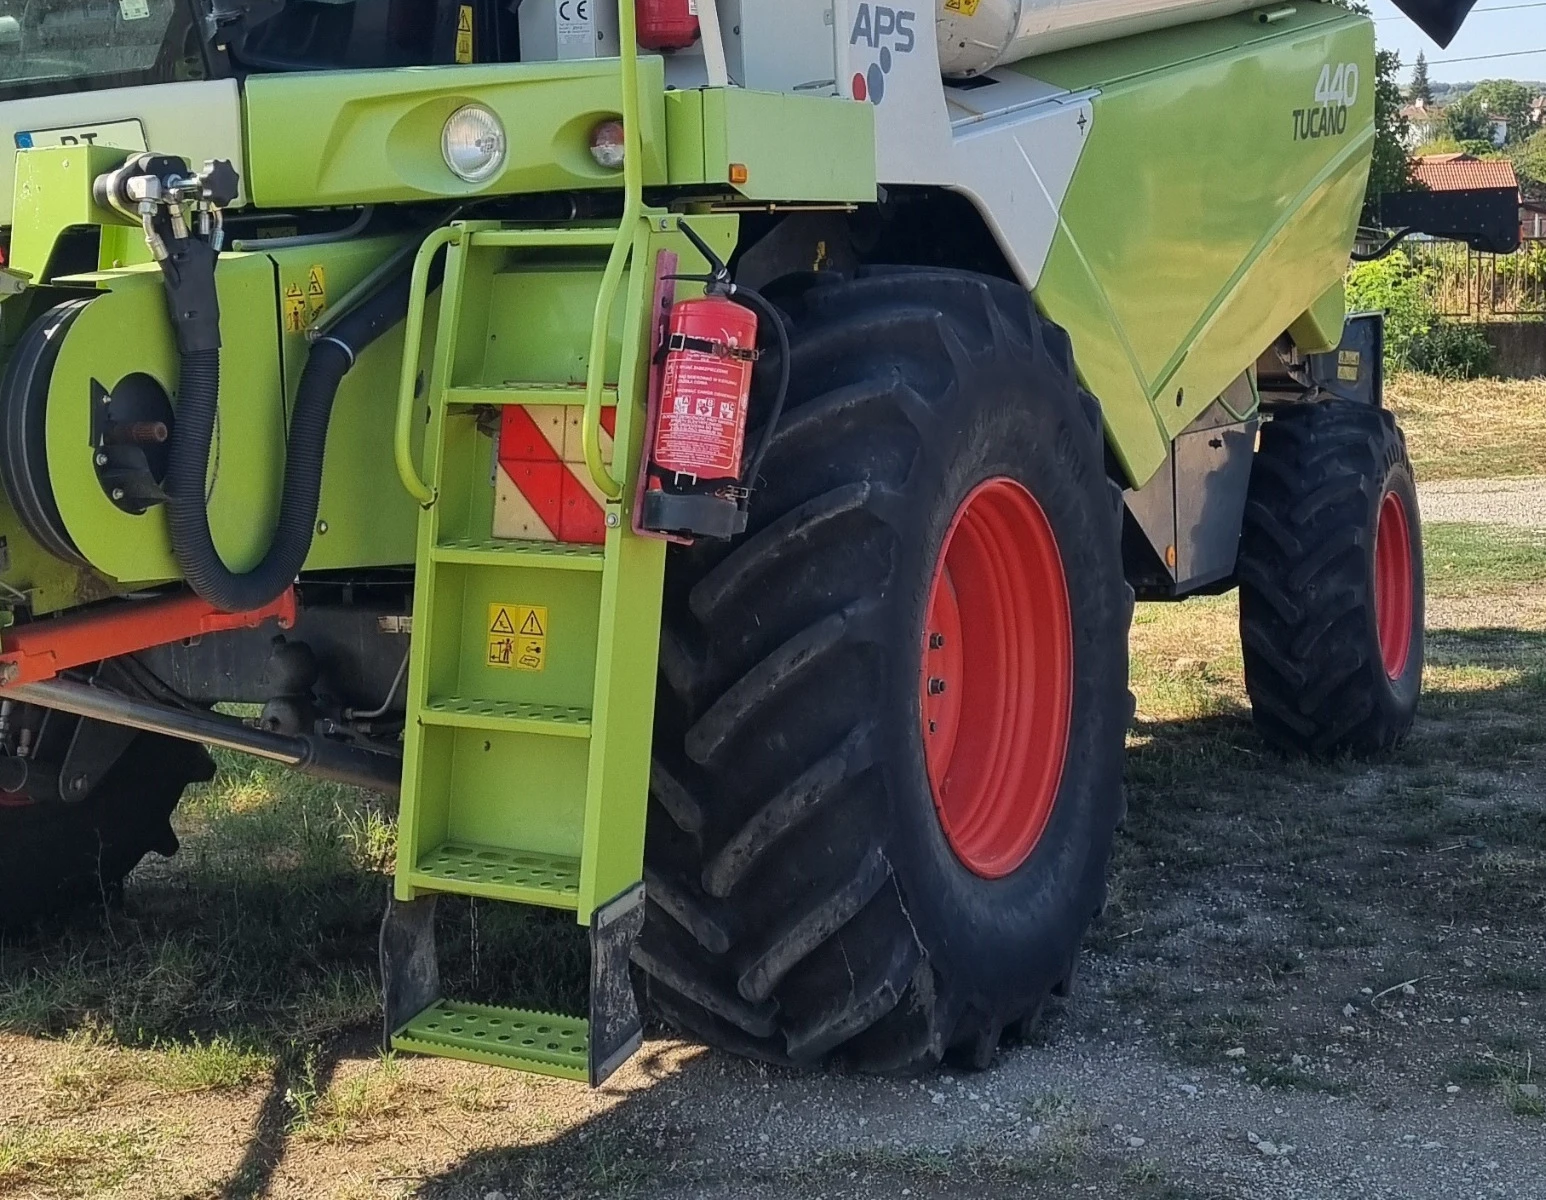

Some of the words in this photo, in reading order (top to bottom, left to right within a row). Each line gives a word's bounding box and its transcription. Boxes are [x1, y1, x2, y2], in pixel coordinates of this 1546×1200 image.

[559, 0, 588, 21] CE
[849, 2, 916, 54] APS
[1314, 62, 1359, 108] 440
[1292, 104, 1348, 141] TUCANO
